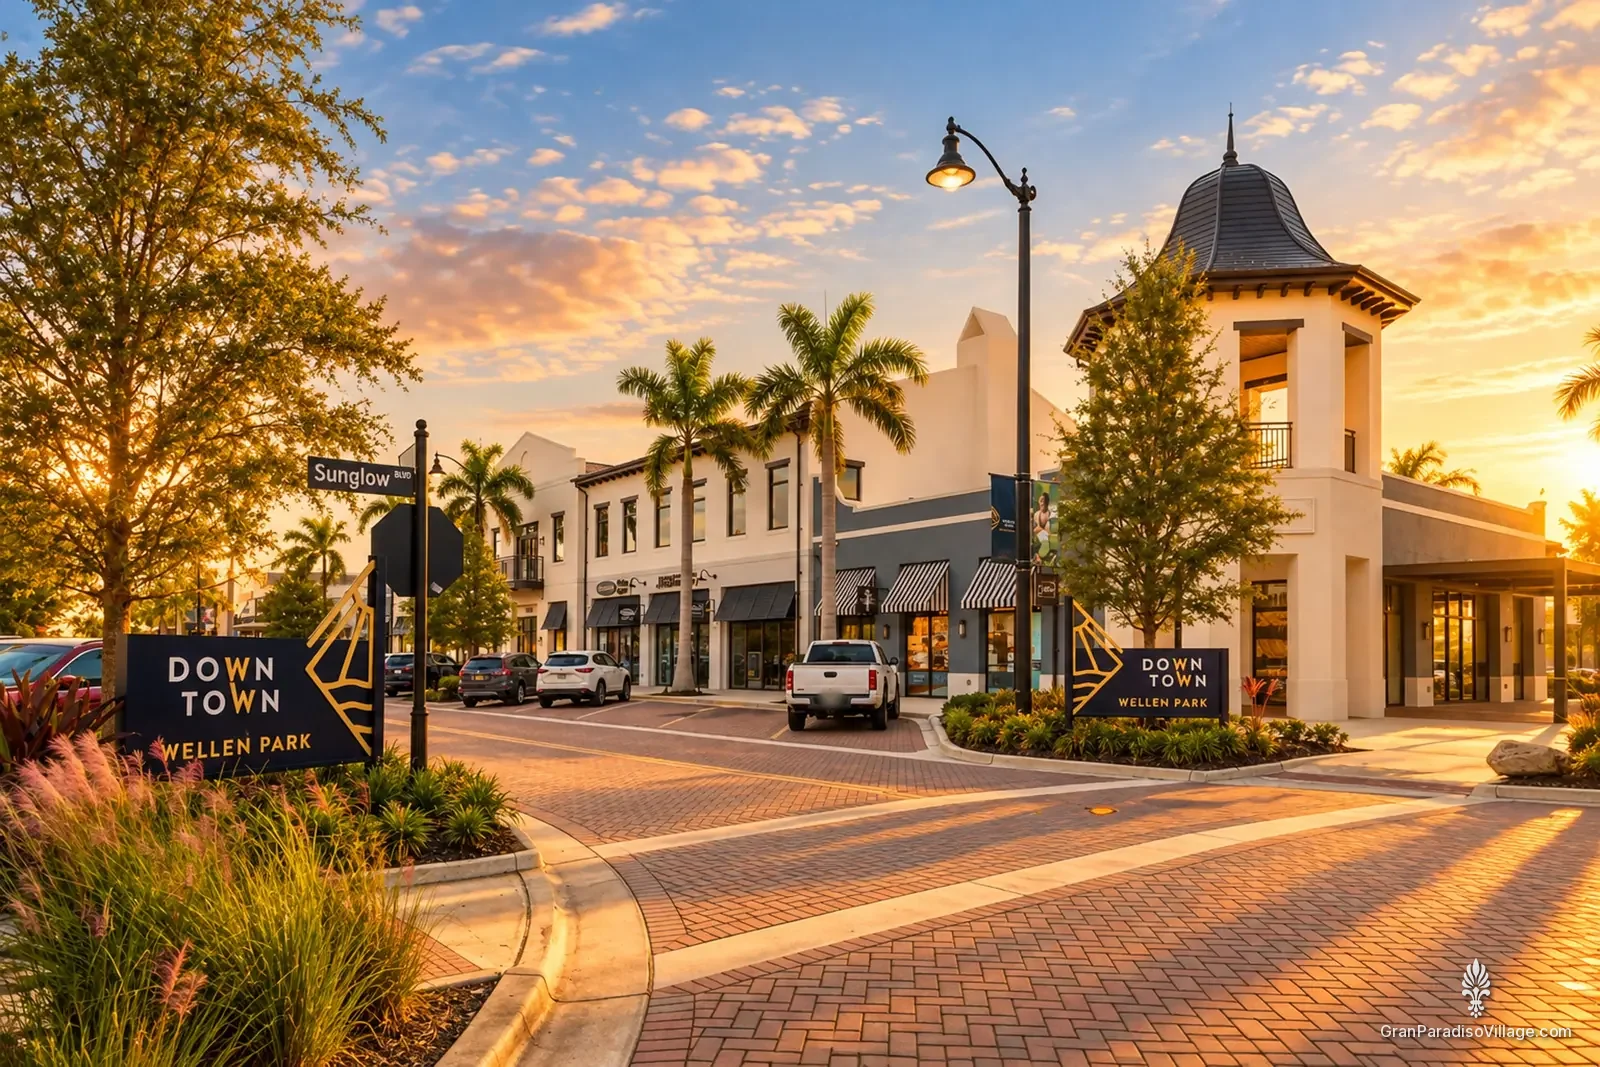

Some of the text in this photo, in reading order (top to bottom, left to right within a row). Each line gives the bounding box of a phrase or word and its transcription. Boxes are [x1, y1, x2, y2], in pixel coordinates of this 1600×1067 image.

[314, 463, 412, 490] Sunglow BLVD
[168, 656, 274, 683] DOWN
[1142, 657, 1202, 671] DOWN
[1149, 671, 1207, 687] TOWN
[181, 682, 280, 717] TOWN
[1119, 697, 1208, 707] WELLEN PARK
[161, 733, 312, 761] WELLEN PARK
